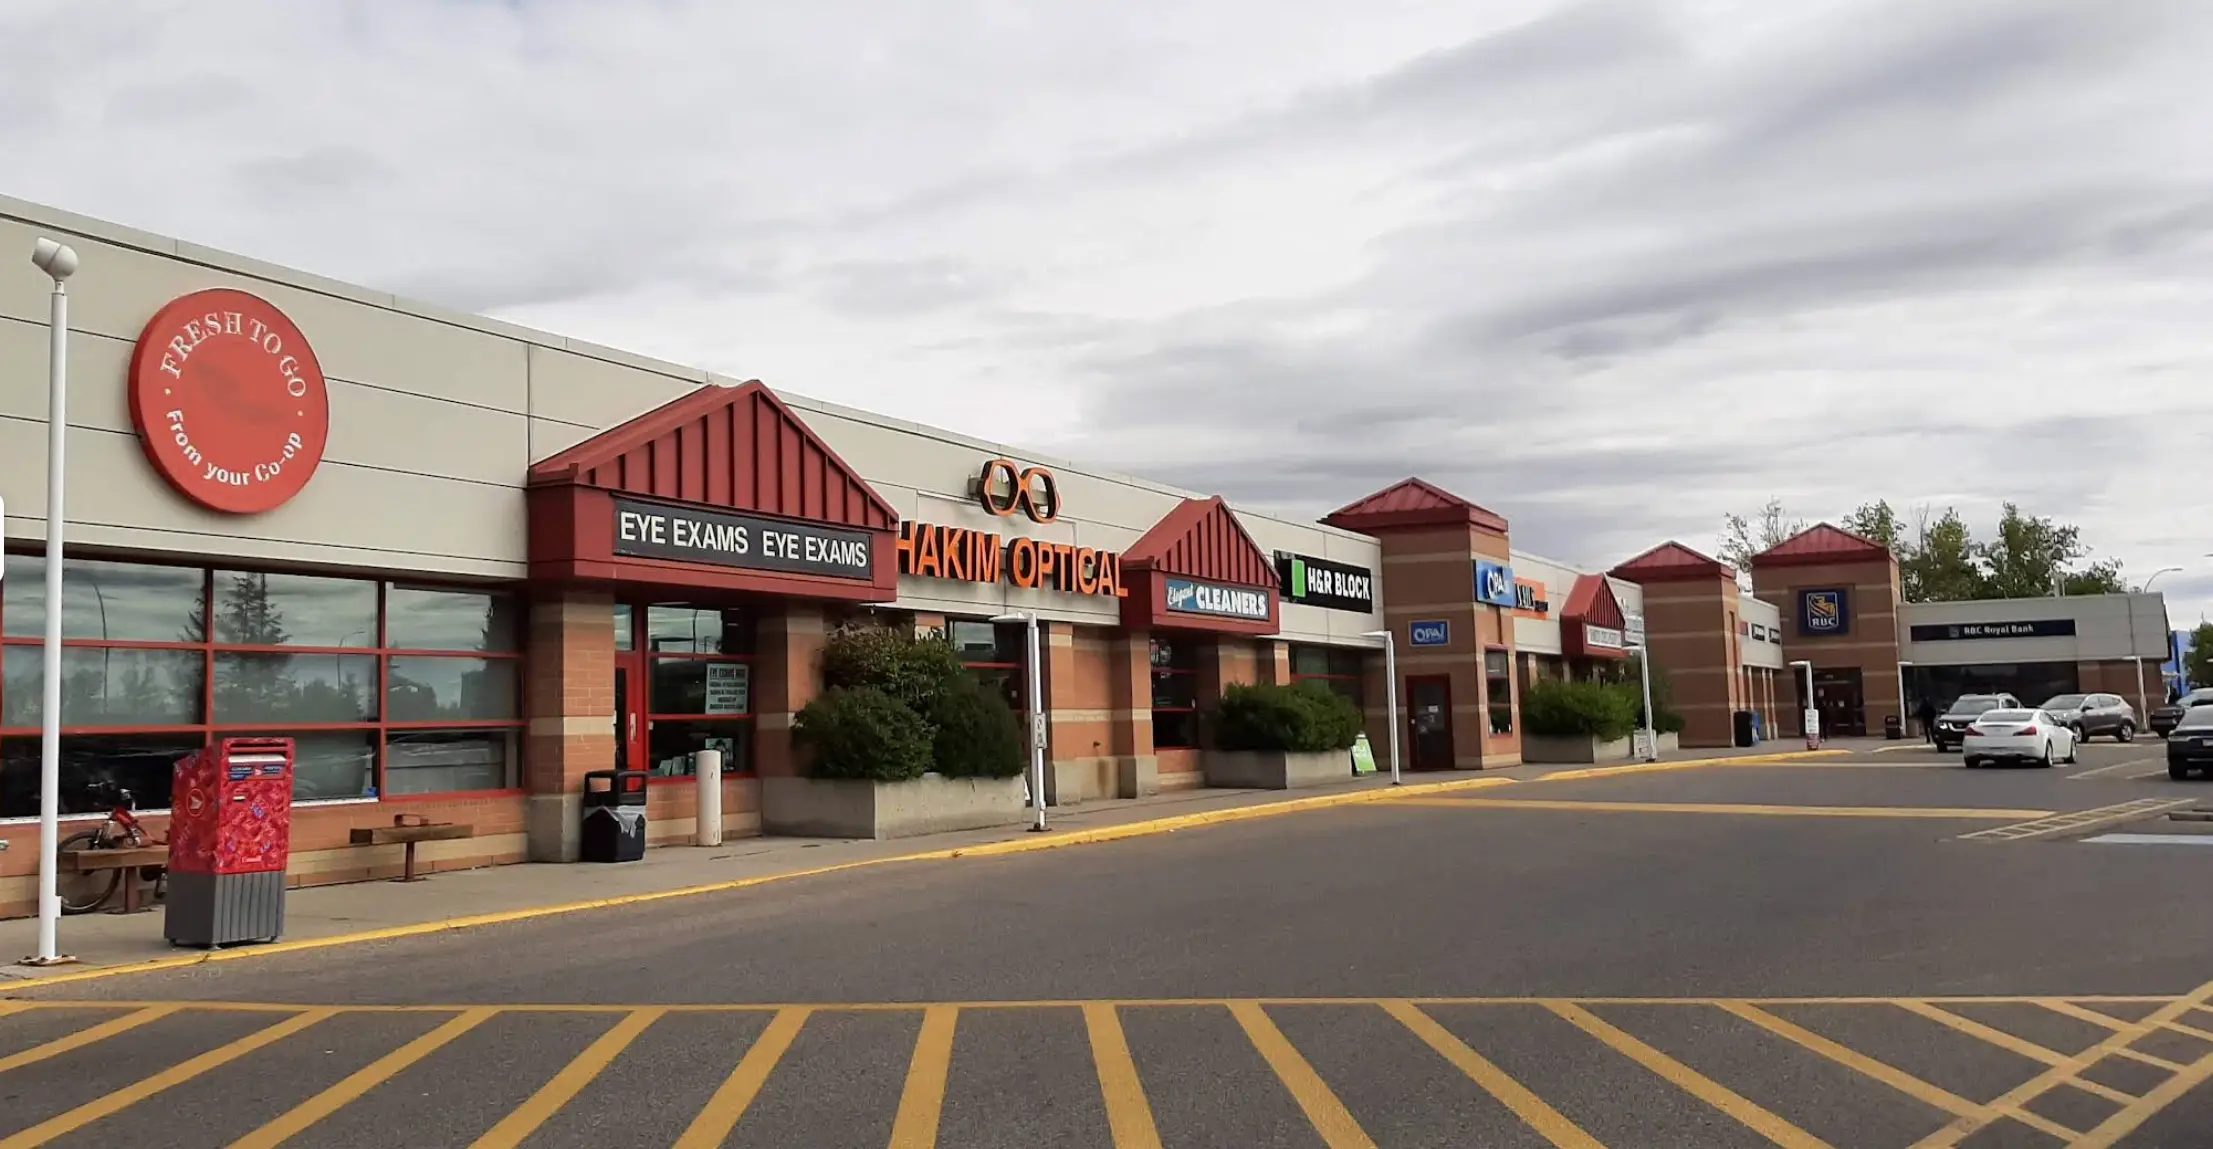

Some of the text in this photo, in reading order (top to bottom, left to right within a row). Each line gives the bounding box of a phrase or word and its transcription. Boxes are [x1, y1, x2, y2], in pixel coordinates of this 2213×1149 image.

[160, 311, 306, 397] FRESH TO GO
[166, 410, 303, 486] From your Co-op
[620, 511, 867, 568] EYE EXAMS EYE EXAMS
[896, 520, 1128, 597] HAKIM OPTICAL
[1195, 585, 1266, 616] CLEANERS
[1307, 566, 1370, 600] H&R BLOCK
[1963, 623, 2034, 636] RBC Royal Bank
